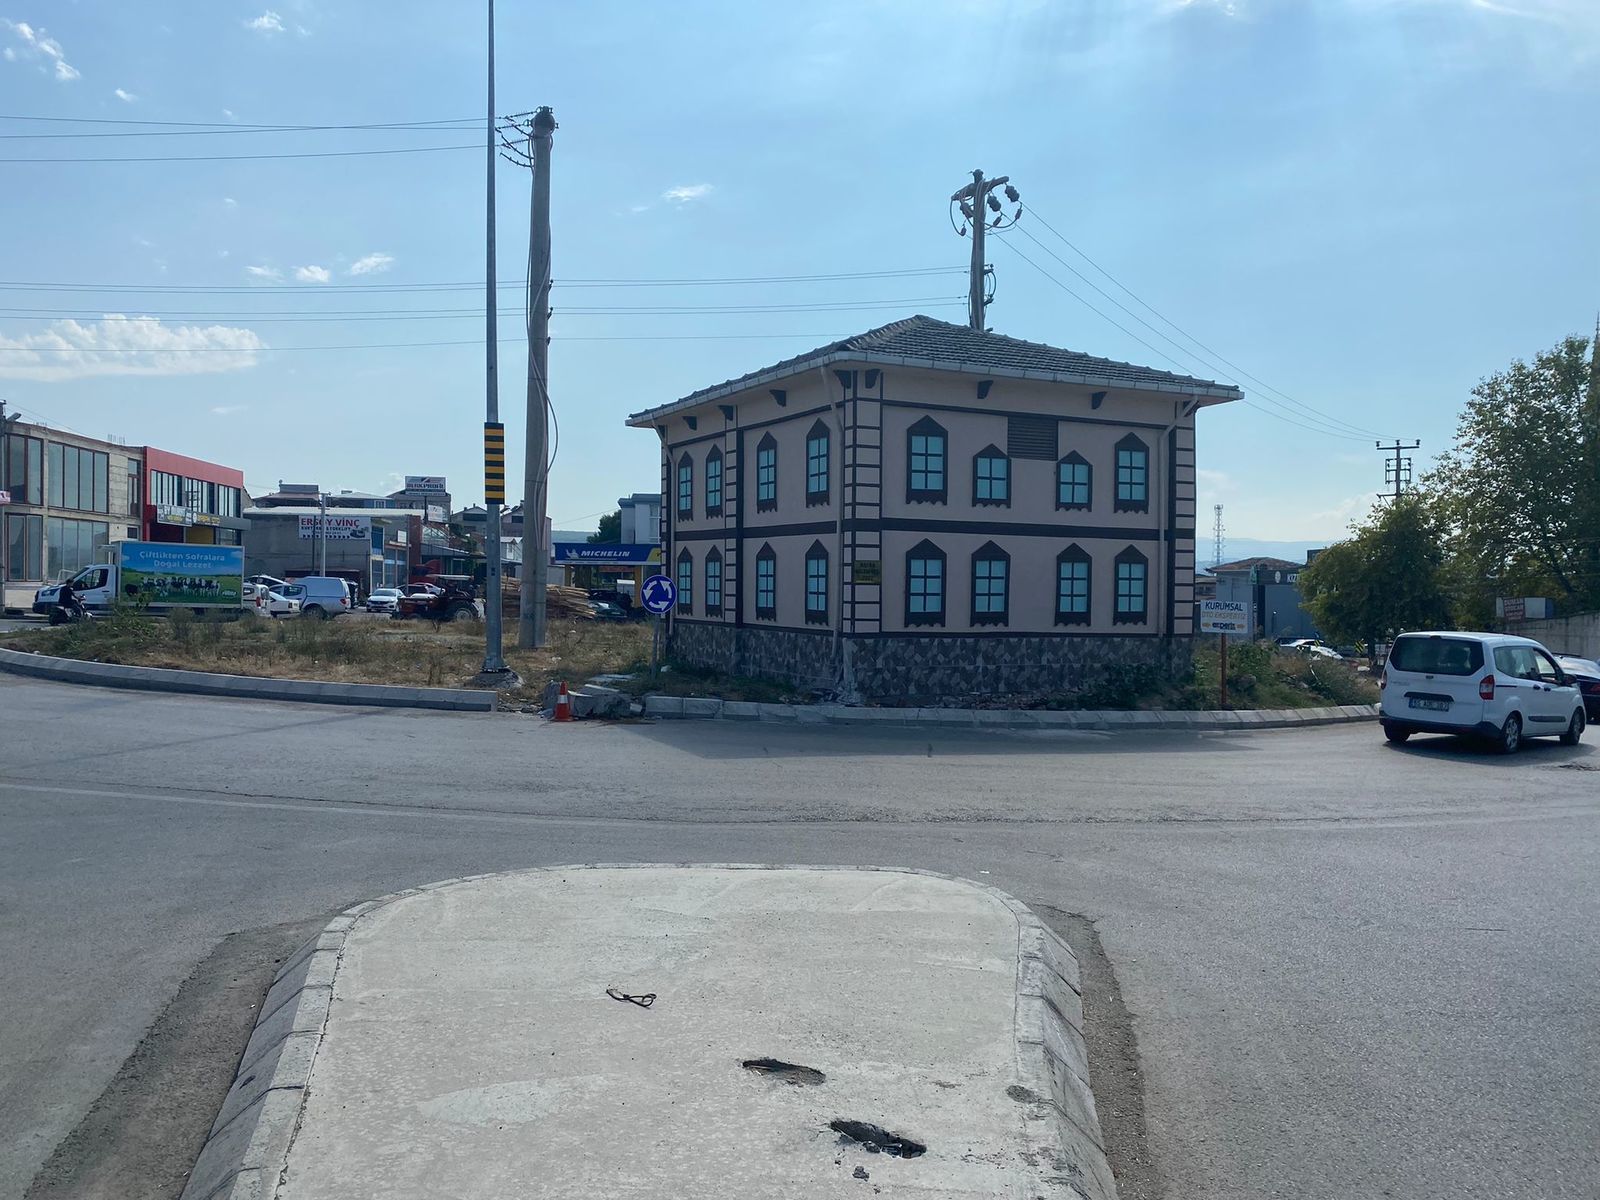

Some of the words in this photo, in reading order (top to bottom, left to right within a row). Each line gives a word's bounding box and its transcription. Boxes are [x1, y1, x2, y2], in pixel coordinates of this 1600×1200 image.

[335, 517, 360, 529] VİNÇ
[139, 550, 183, 561] Çiftlikten
[185, 553, 225, 562] Sofralara
[580, 550, 630, 558] MICHELIN
[182, 561, 212, 569] Lezzet
[1205, 601, 1244, 612] KURUMSAL
